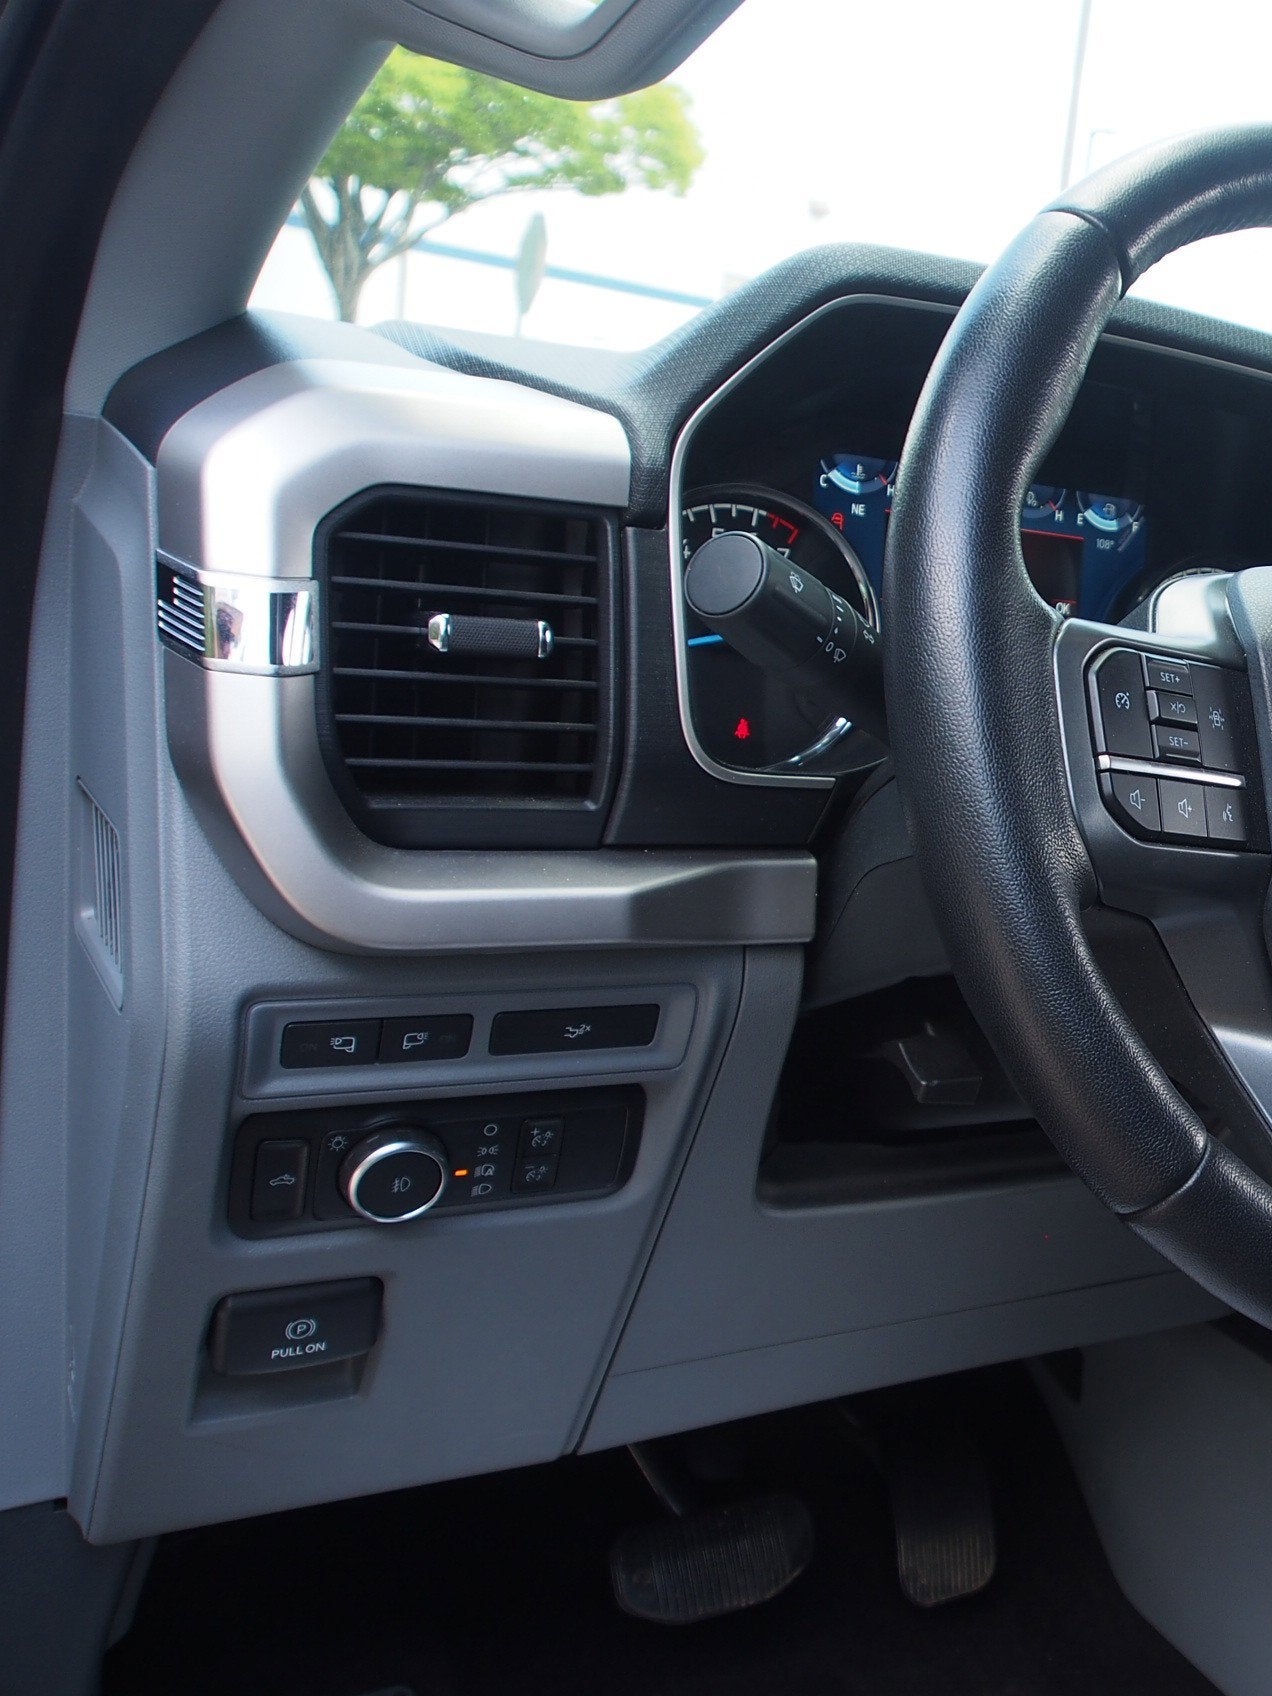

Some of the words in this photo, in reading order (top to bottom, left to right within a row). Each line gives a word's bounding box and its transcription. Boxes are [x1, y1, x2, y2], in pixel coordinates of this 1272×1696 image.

[850, 503, 866, 516] NE
[1054, 509, 1064, 522] H
[1076, 513, 1085, 526] E
[1096, 538, 1114, 550] 108°
[1160, 671, 1181, 684] SET+
[1168, 736, 1189, 748] SET-
[270, 1346, 304, 1360] PULL
[305, 1341, 327, 1354] ON
